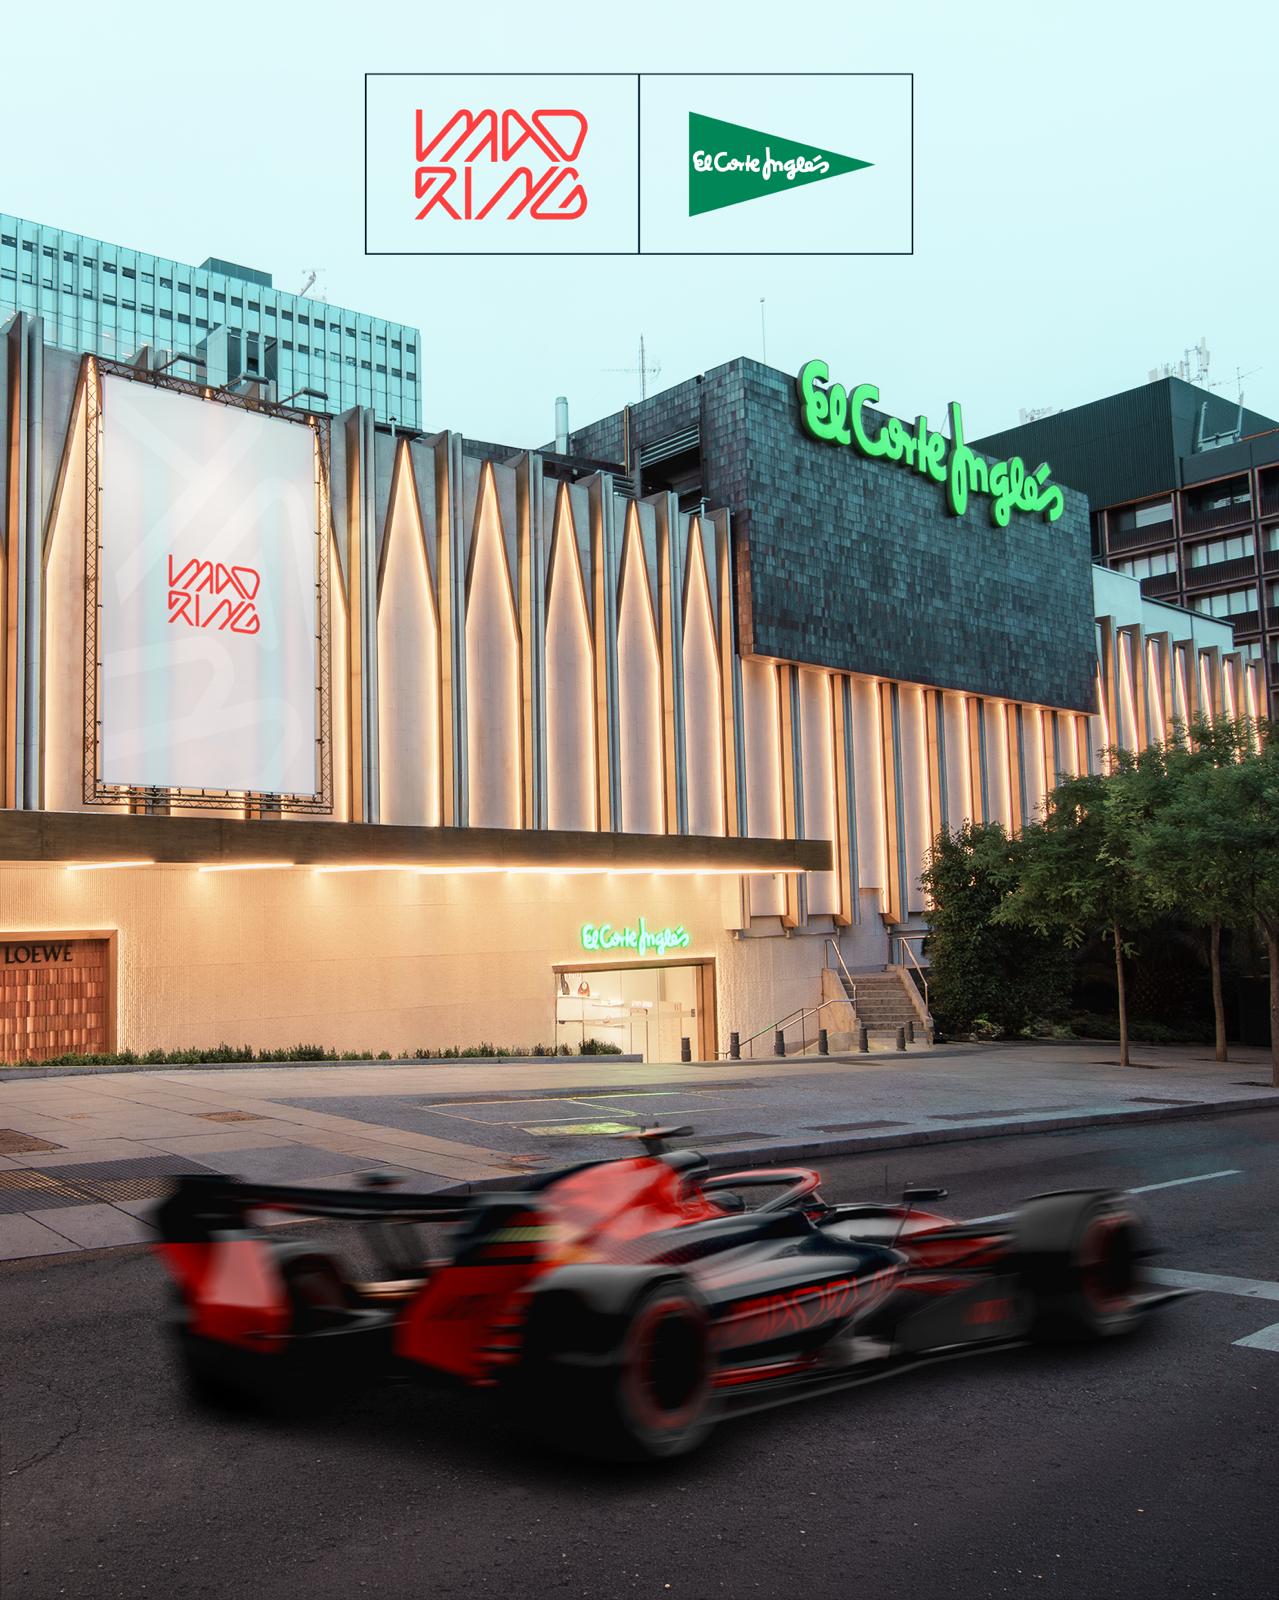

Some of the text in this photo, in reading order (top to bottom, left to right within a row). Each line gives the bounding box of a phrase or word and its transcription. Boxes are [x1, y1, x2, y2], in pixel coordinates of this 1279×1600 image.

[797, 359, 1064, 528] El Corte Inglés
[5, 944, 73, 964] LOEWE
[582, 916, 690, 956] El Corte Inglés
